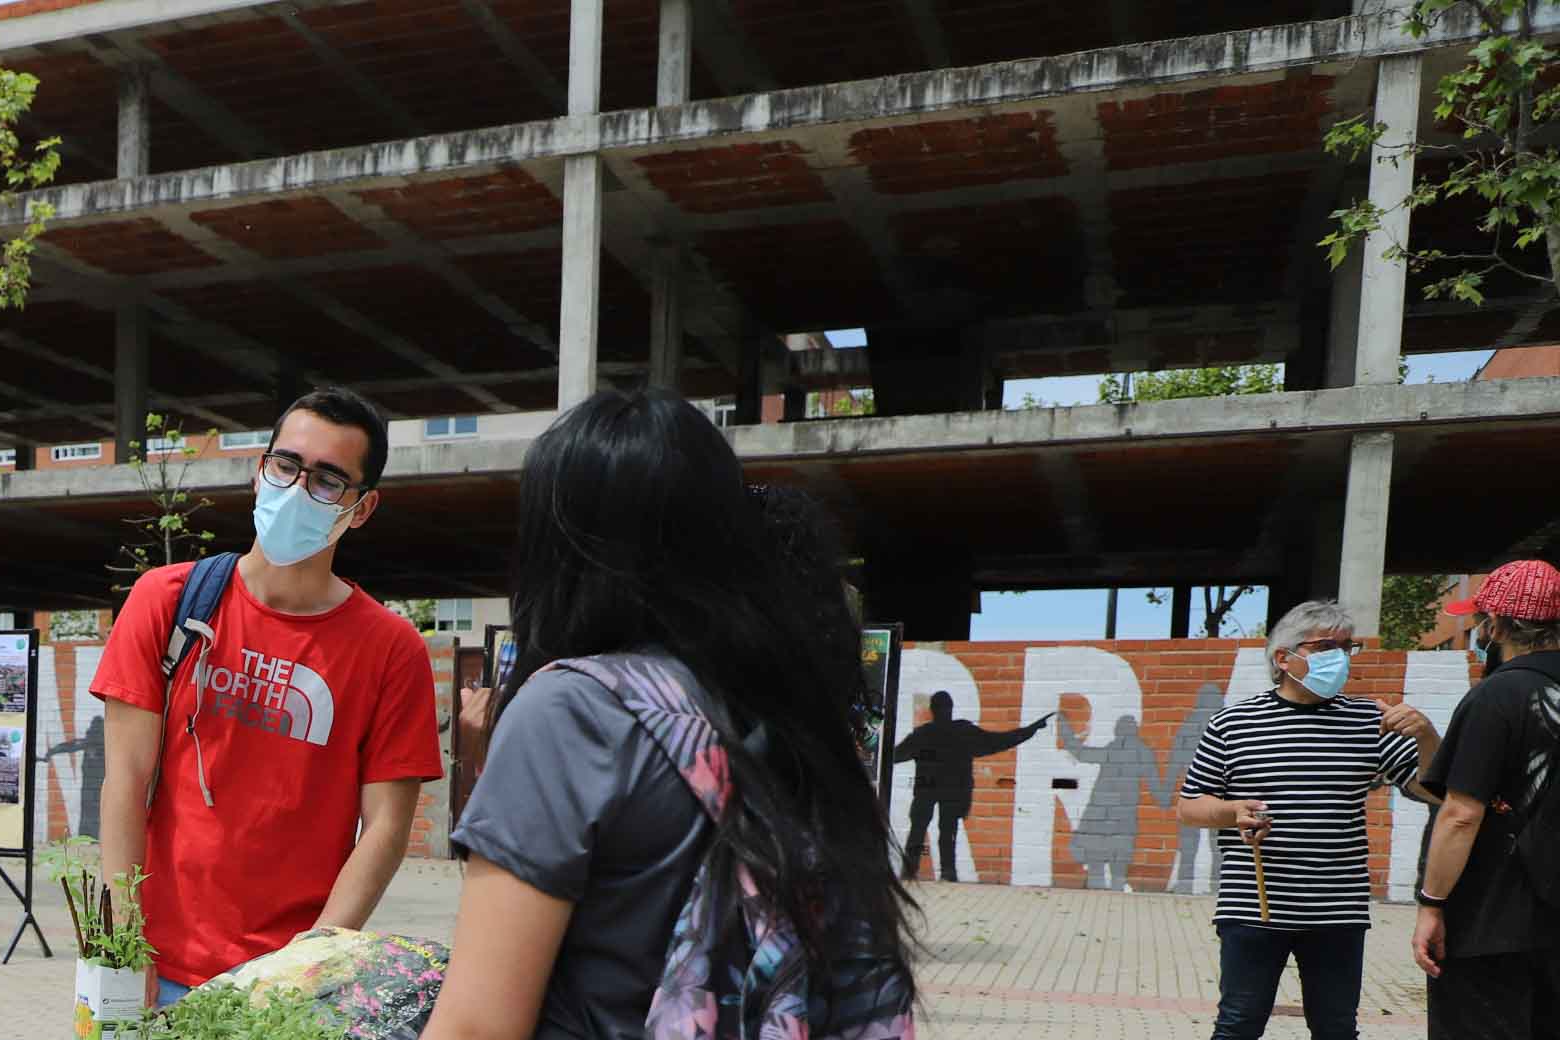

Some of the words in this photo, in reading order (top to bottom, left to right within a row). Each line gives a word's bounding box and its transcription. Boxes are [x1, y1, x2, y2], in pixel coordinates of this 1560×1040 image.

[190, 660, 288, 710] NORTH
[242, 648, 293, 684] THE
[214, 694, 278, 733] FACE
